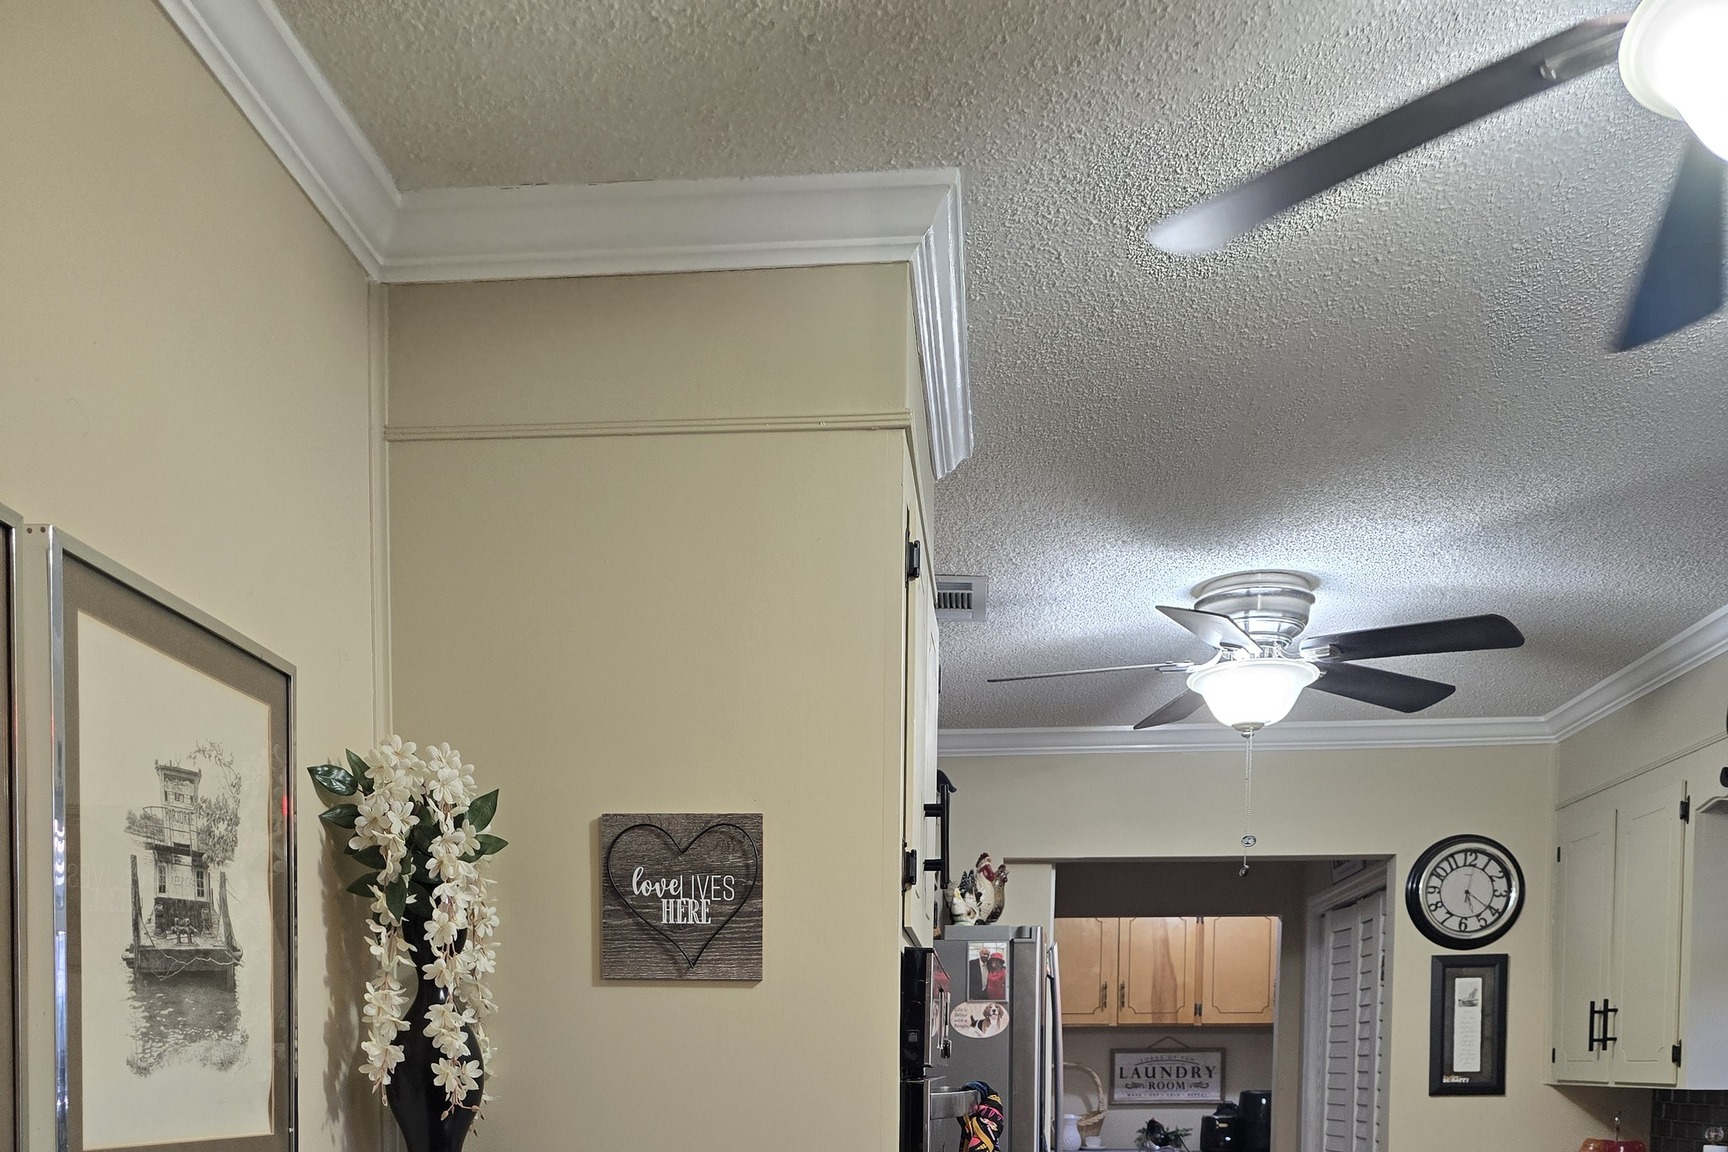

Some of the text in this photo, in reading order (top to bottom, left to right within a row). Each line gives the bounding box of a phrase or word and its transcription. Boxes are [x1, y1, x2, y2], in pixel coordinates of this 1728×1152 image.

[1447, 854, 1459, 871] 11
[1463, 851, 1478, 867] 12
[1482, 857, 1492, 871] 1
[1432, 865, 1448, 882] 10
[1488, 870, 1506, 883] 2
[632, 867, 735, 901] love LIVES
[1427, 885, 1441, 895] 9
[1493, 889, 1508, 898] 3
[661, 898, 711, 924] HERE
[1428, 900, 1444, 912] 8
[1488, 905, 1502, 917] 4
[1440, 911, 1454, 925] 7
[1458, 916, 1468, 932] 6
[1474, 913, 1488, 929] 5
[1119, 1066, 1216, 1079] LAUNDRY
[1148, 1081, 1185, 1090] ROOM
